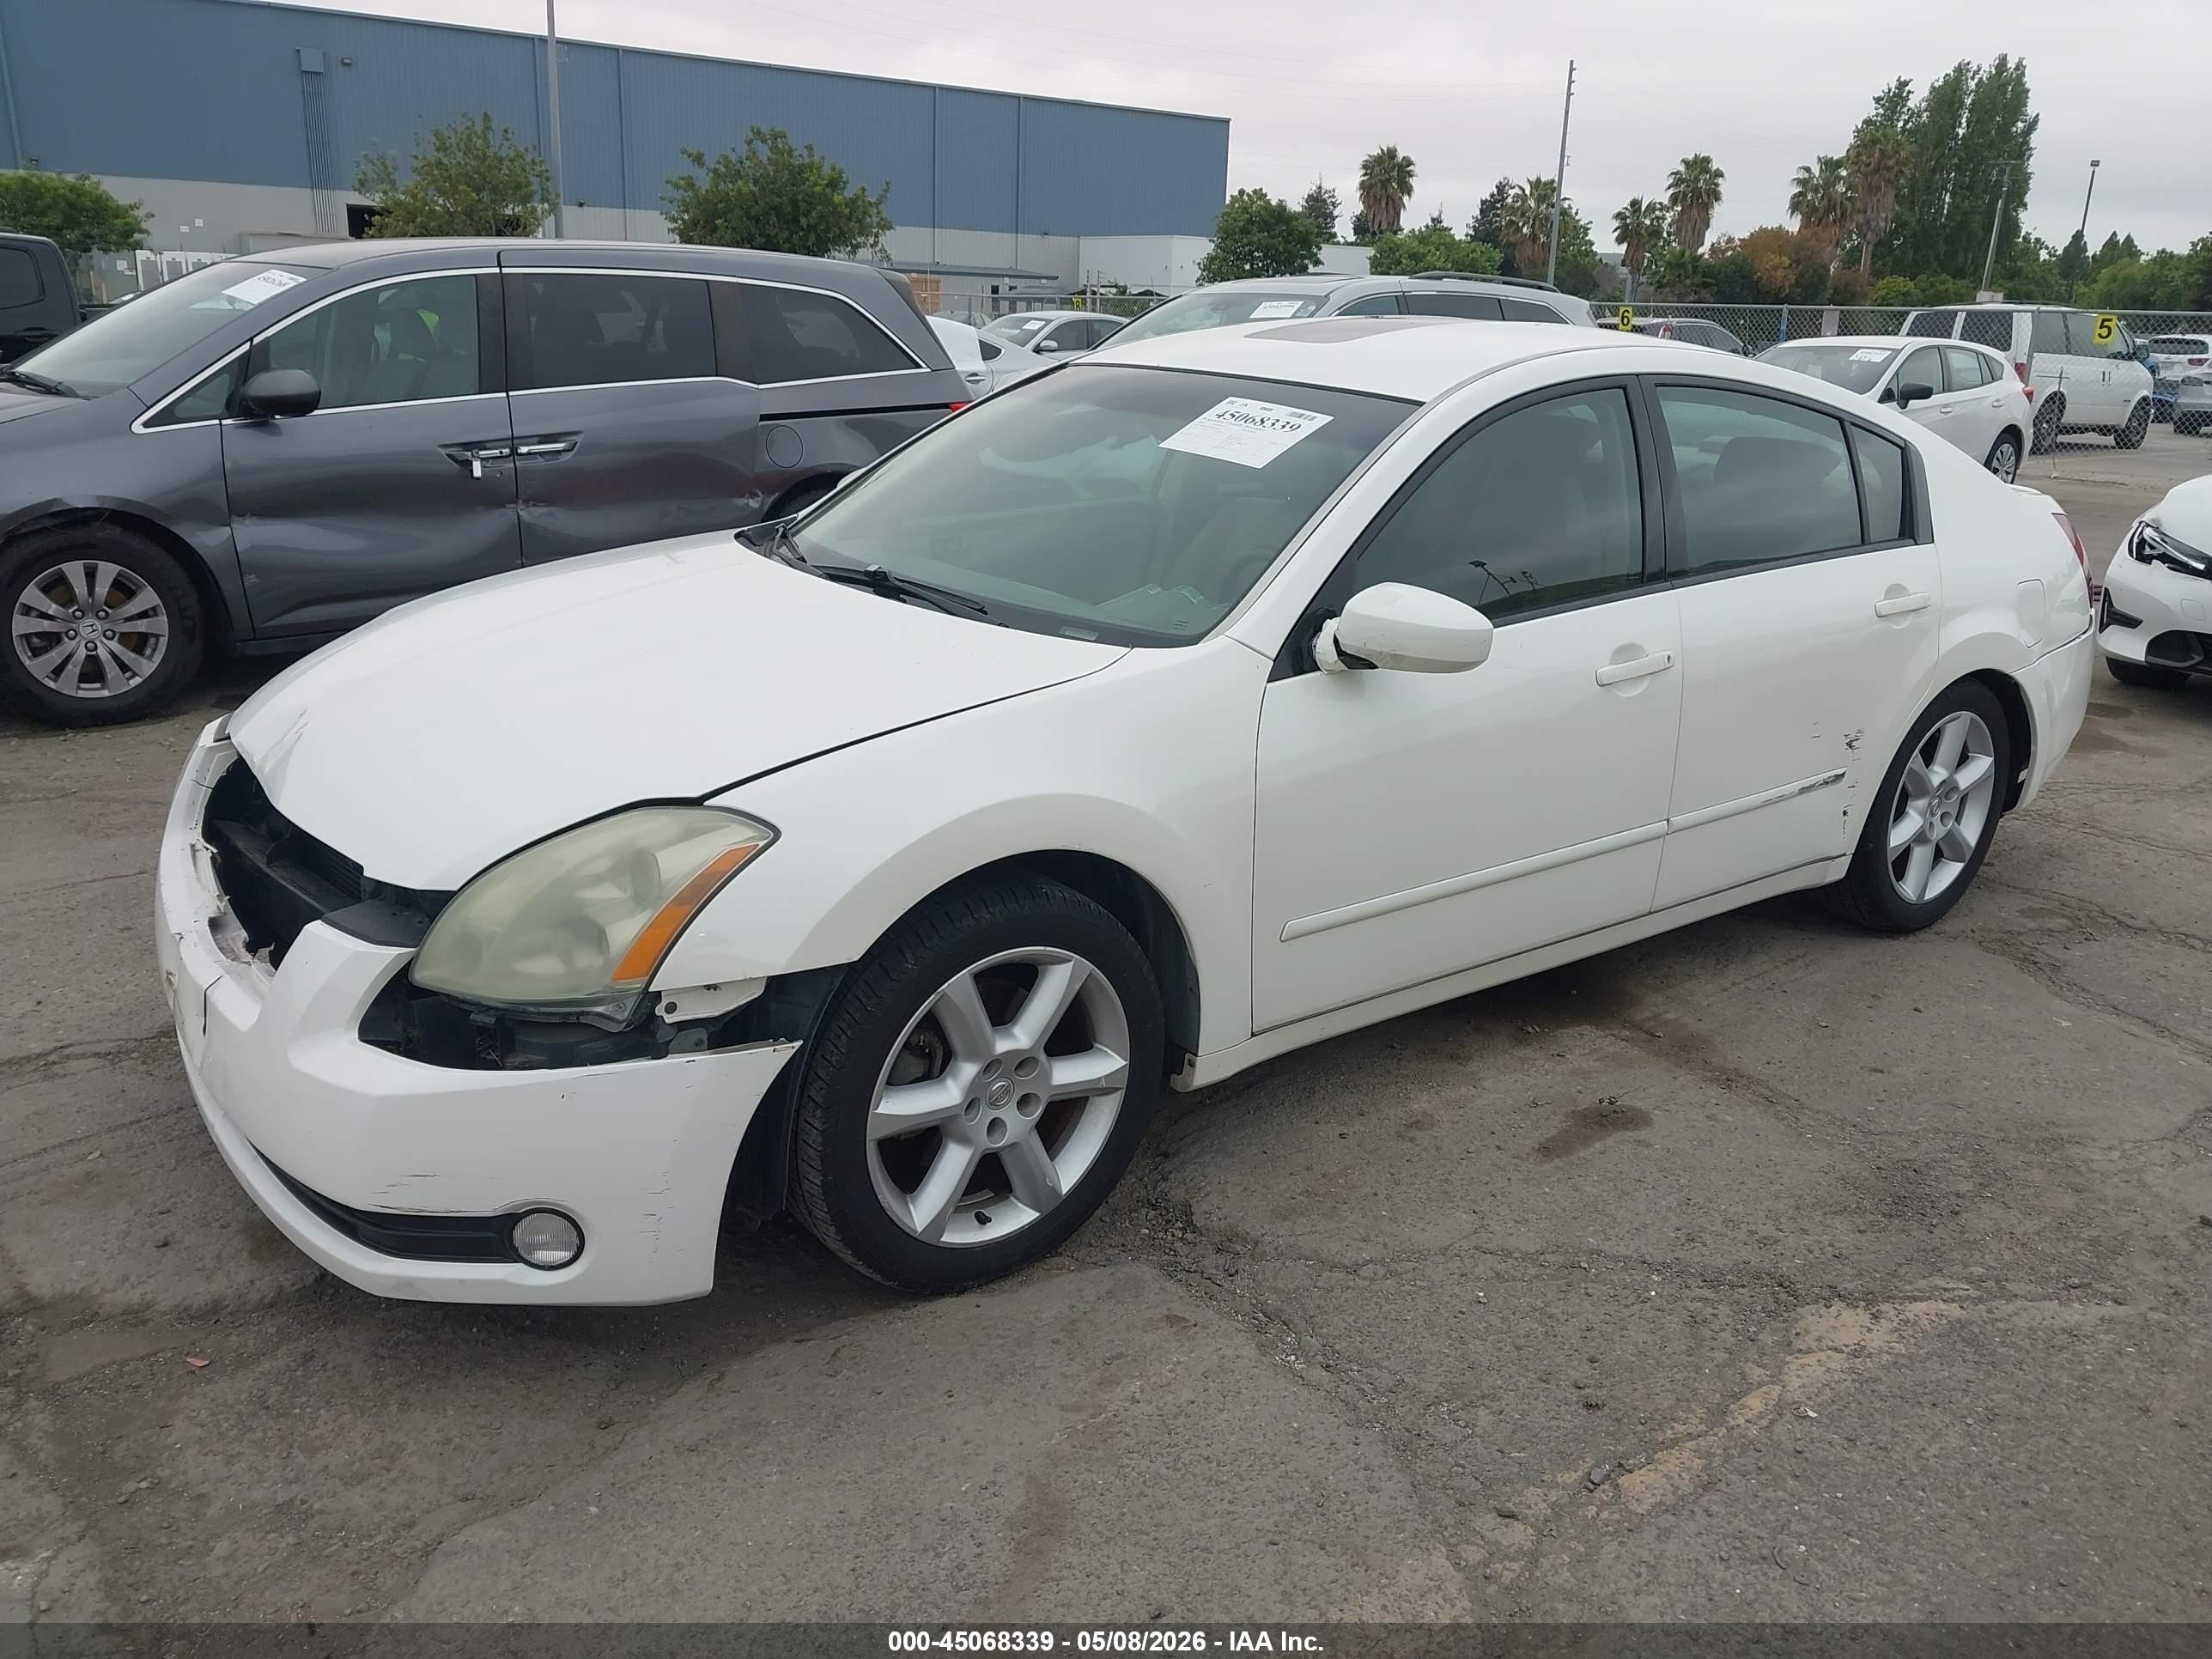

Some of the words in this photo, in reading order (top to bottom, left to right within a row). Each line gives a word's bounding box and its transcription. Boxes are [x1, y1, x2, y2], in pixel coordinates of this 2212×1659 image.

[1621, 309, 1631, 326] 6
[2098, 318, 2113, 339] 5
[1215, 410, 1302, 433] 45068339
